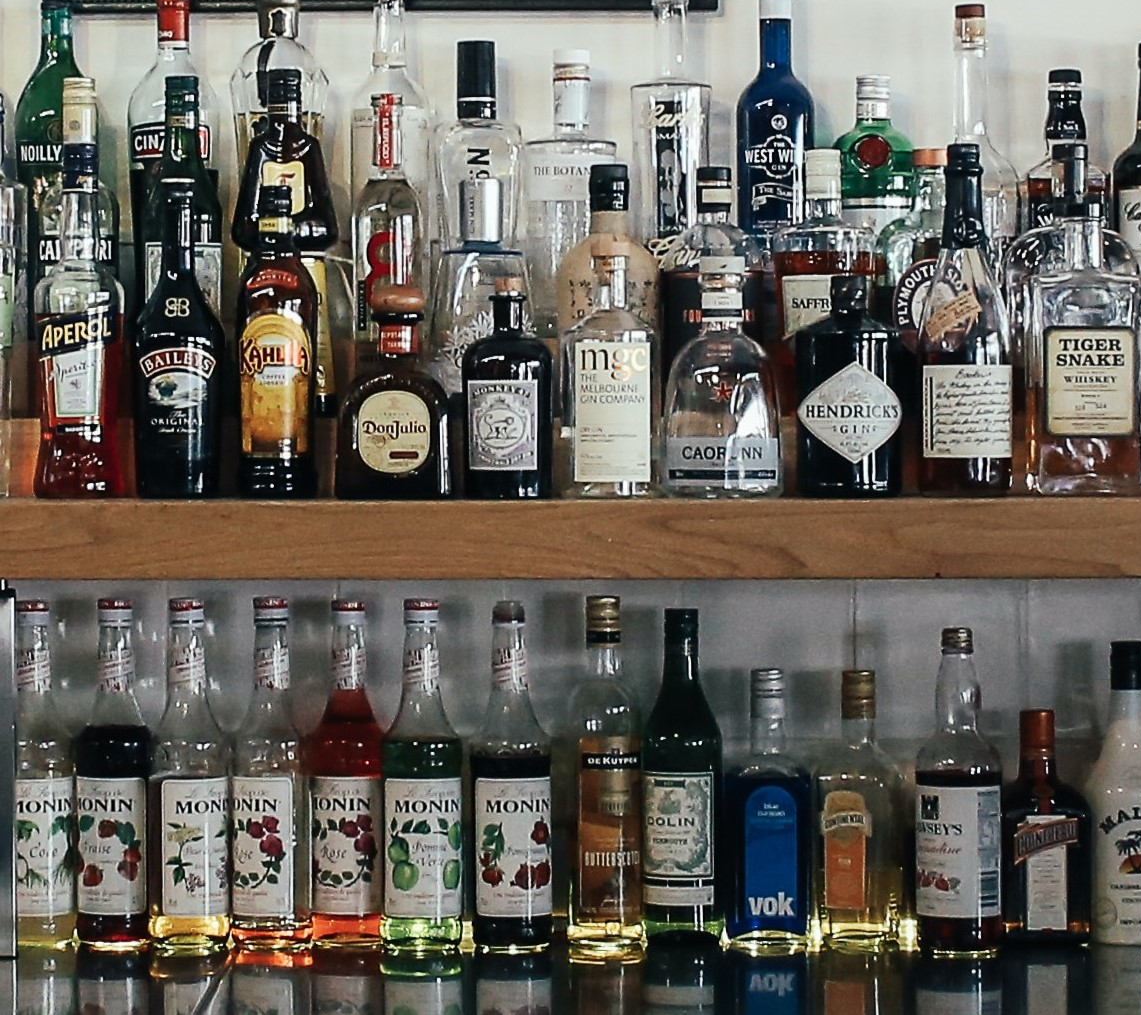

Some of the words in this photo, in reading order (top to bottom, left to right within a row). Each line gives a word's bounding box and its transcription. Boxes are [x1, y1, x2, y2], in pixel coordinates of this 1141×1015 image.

[20, 144, 62, 162] NOILLY
[898, 263, 938, 326] PLYMOUTH
[42, 317, 112, 351] APEROL
[1059, 338, 1122, 352] TIGER
[144, 351, 212, 373] BAILEYS
[580, 348, 647, 382] mgc
[1056, 353, 1125, 367] SNAKE
[580, 373, 598, 383] THE
[1063, 375, 1118, 384] WHISKEY
[580, 384, 638, 393] MELBOURNE
[580, 395, 597, 404] GIN
[599, 395, 646, 404] COMPANY
[805, 404, 899, 419] HENDRICK'S
[839, 425, 871, 434] GIN
[394, 799, 461, 814] MONIN
[486, 799, 550, 813] MONIN
[647, 816, 695, 827] DOLIN
[748, 892, 796, 917] vok
